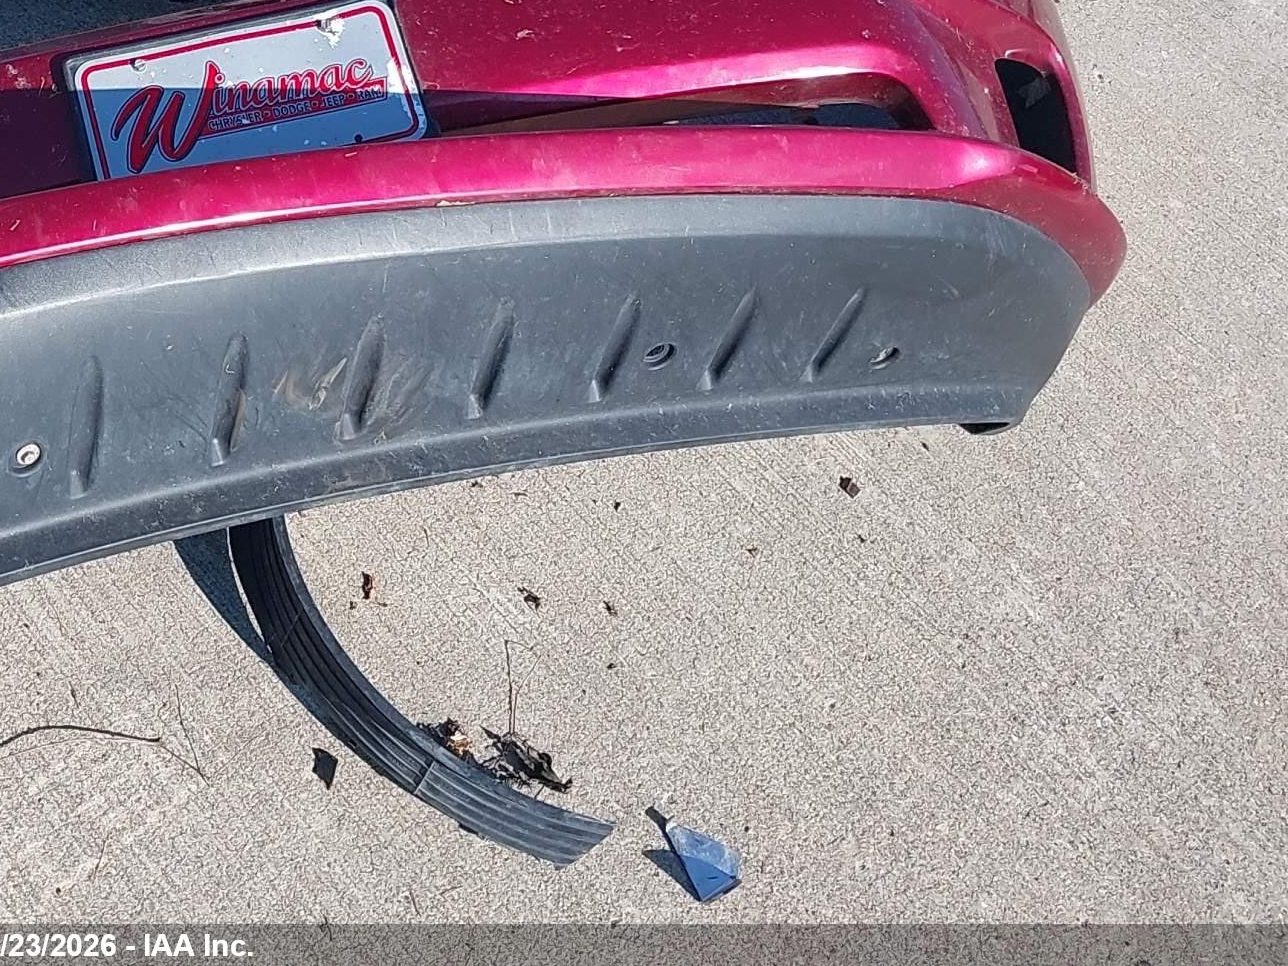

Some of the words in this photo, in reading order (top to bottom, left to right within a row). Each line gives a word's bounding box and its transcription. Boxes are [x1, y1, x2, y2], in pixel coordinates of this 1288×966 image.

[110, 57, 374, 174] Winamac
[272, 101, 312, 118] DODGE
[321, 94, 346, 108] JEEP
[357, 87, 383, 101] RAM
